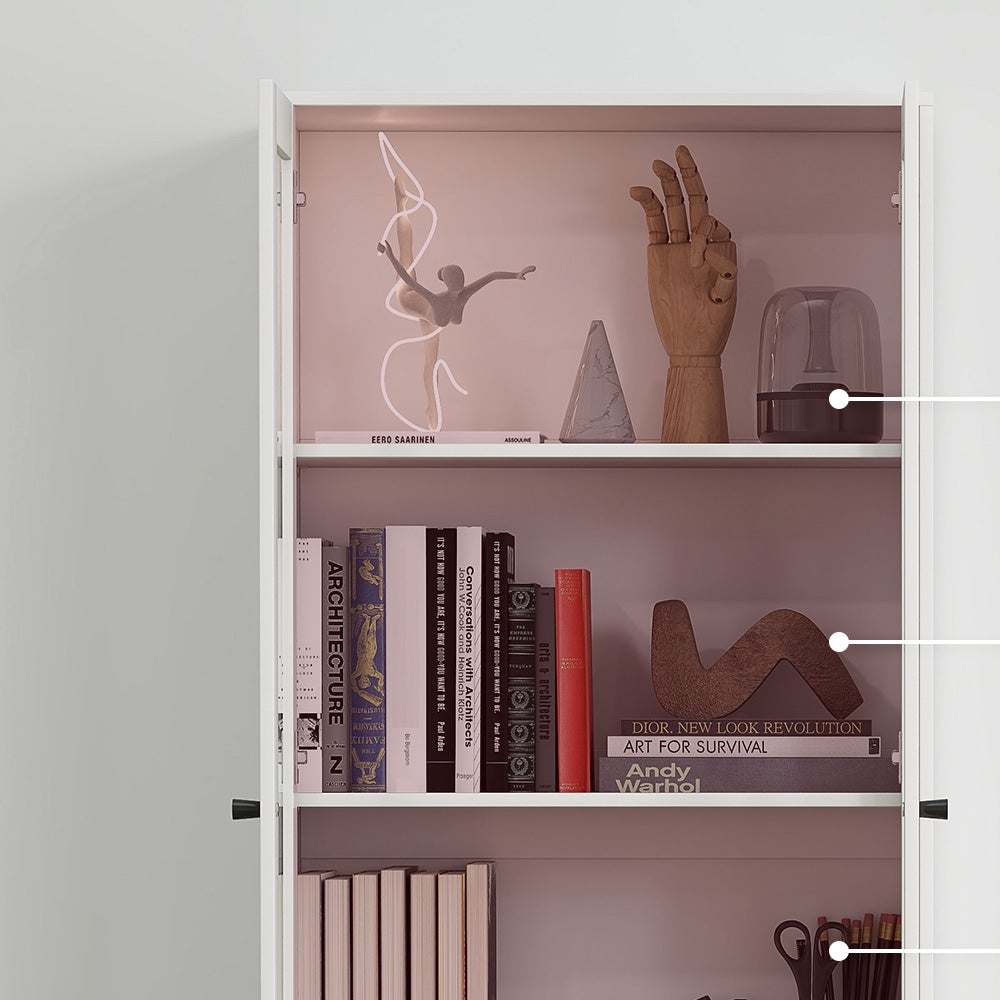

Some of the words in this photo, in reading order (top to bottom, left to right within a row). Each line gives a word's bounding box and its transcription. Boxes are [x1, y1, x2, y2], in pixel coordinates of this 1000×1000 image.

[371, 436, 391, 444] EERO
[395, 436, 435, 444] SAARINEN
[437, 537, 445, 548] IT'S
[437, 550, 445, 560] NOT
[437, 562, 445, 575] HOW
[458, 567, 466, 591] John
[437, 593, 445, 604] YOU
[465, 566, 474, 653] Conversations
[437, 621, 445, 631] IT'S
[328, 561, 344, 725] ARCHITECTURE
[437, 633, 445, 645] HOW
[539, 643, 550, 662] arts
[465, 658, 473, 682] with
[437, 677, 445, 692] WANT
[457, 698, 465, 721] Klotz
[465, 686, 473, 748] Architects
[539, 679, 551, 740] architecture
[437, 721, 445, 734] Paul
[632, 722, 672, 734] DIOR.
[678, 722, 711, 734] NEW
[717, 722, 759, 734] LOOK
[764, 722, 862, 734] REVOLUTION
[437, 736, 445, 751] Arden
[623, 740, 653, 754] ART
[659, 740, 690, 754] FOR
[696, 740, 768, 754] SURVIVAL
[626, 763, 691, 781] Andy
[615, 778, 700, 793] Warhol
